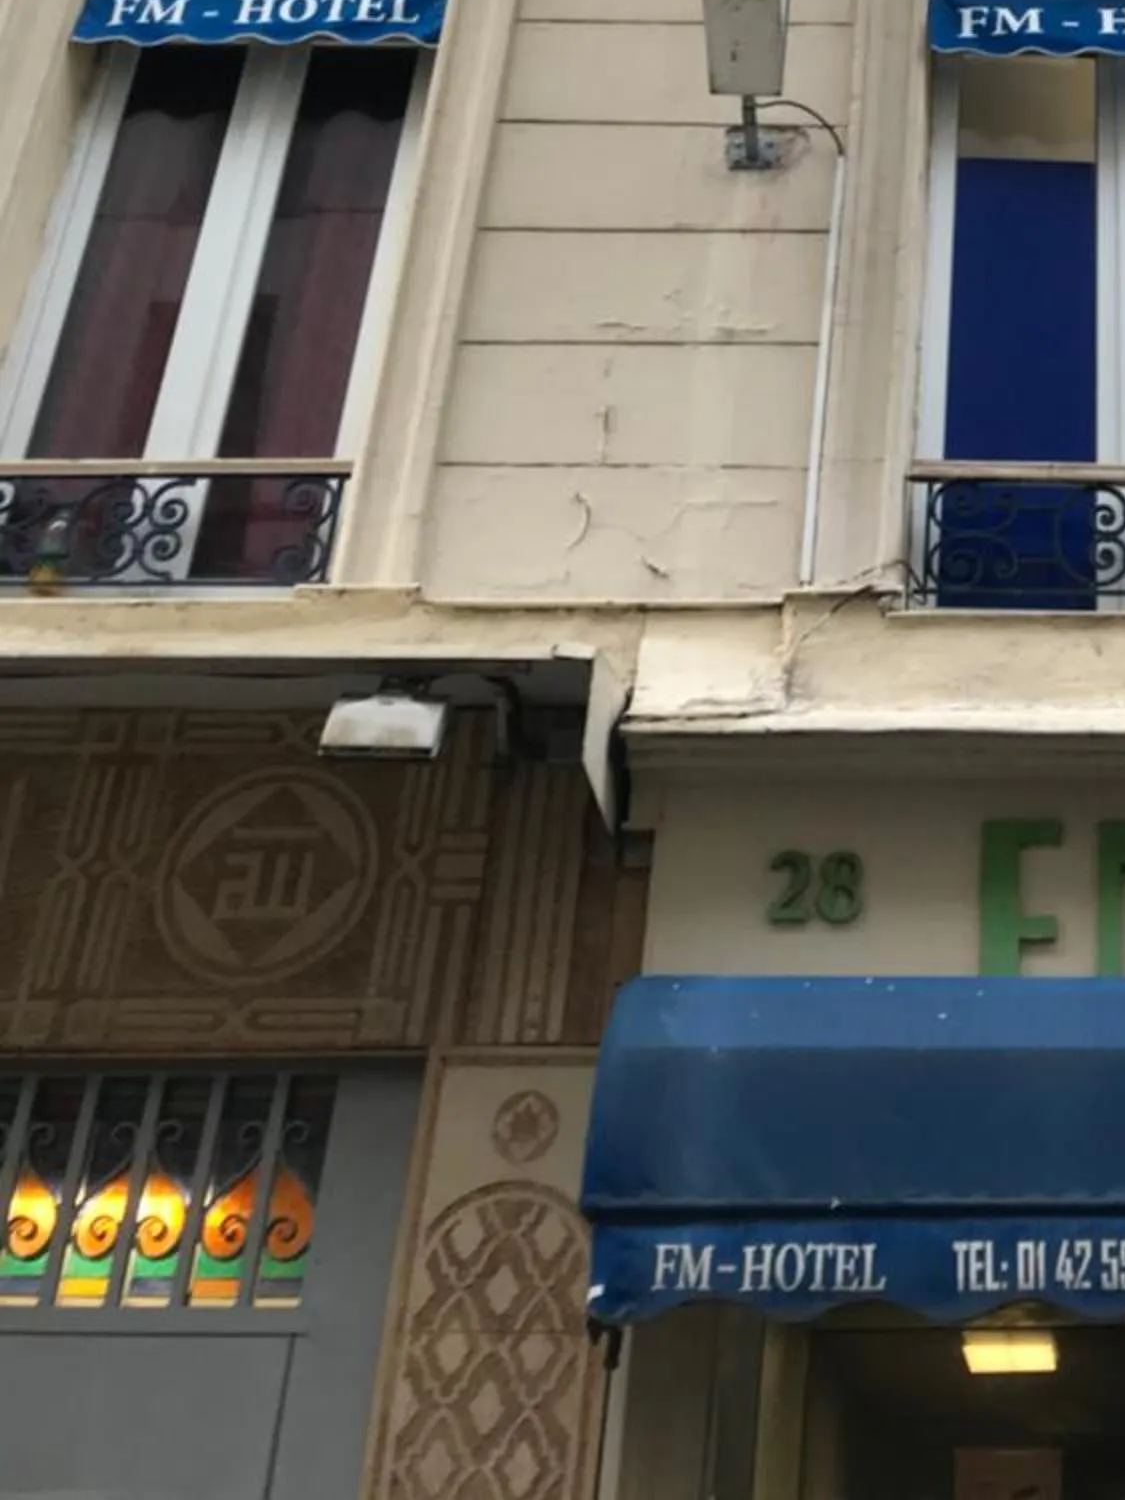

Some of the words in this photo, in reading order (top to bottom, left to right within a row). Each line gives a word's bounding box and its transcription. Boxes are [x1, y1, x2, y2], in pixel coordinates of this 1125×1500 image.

[955, 6, 1044, 39] FM
[766, 850, 864, 927] 28
[651, 1242, 888, 1293] FM-HOTEL
[953, 1239, 1009, 1292] TEL:
[1017, 1240, 1046, 1291] 01
[1055, 1238, 1093, 1290] 42
